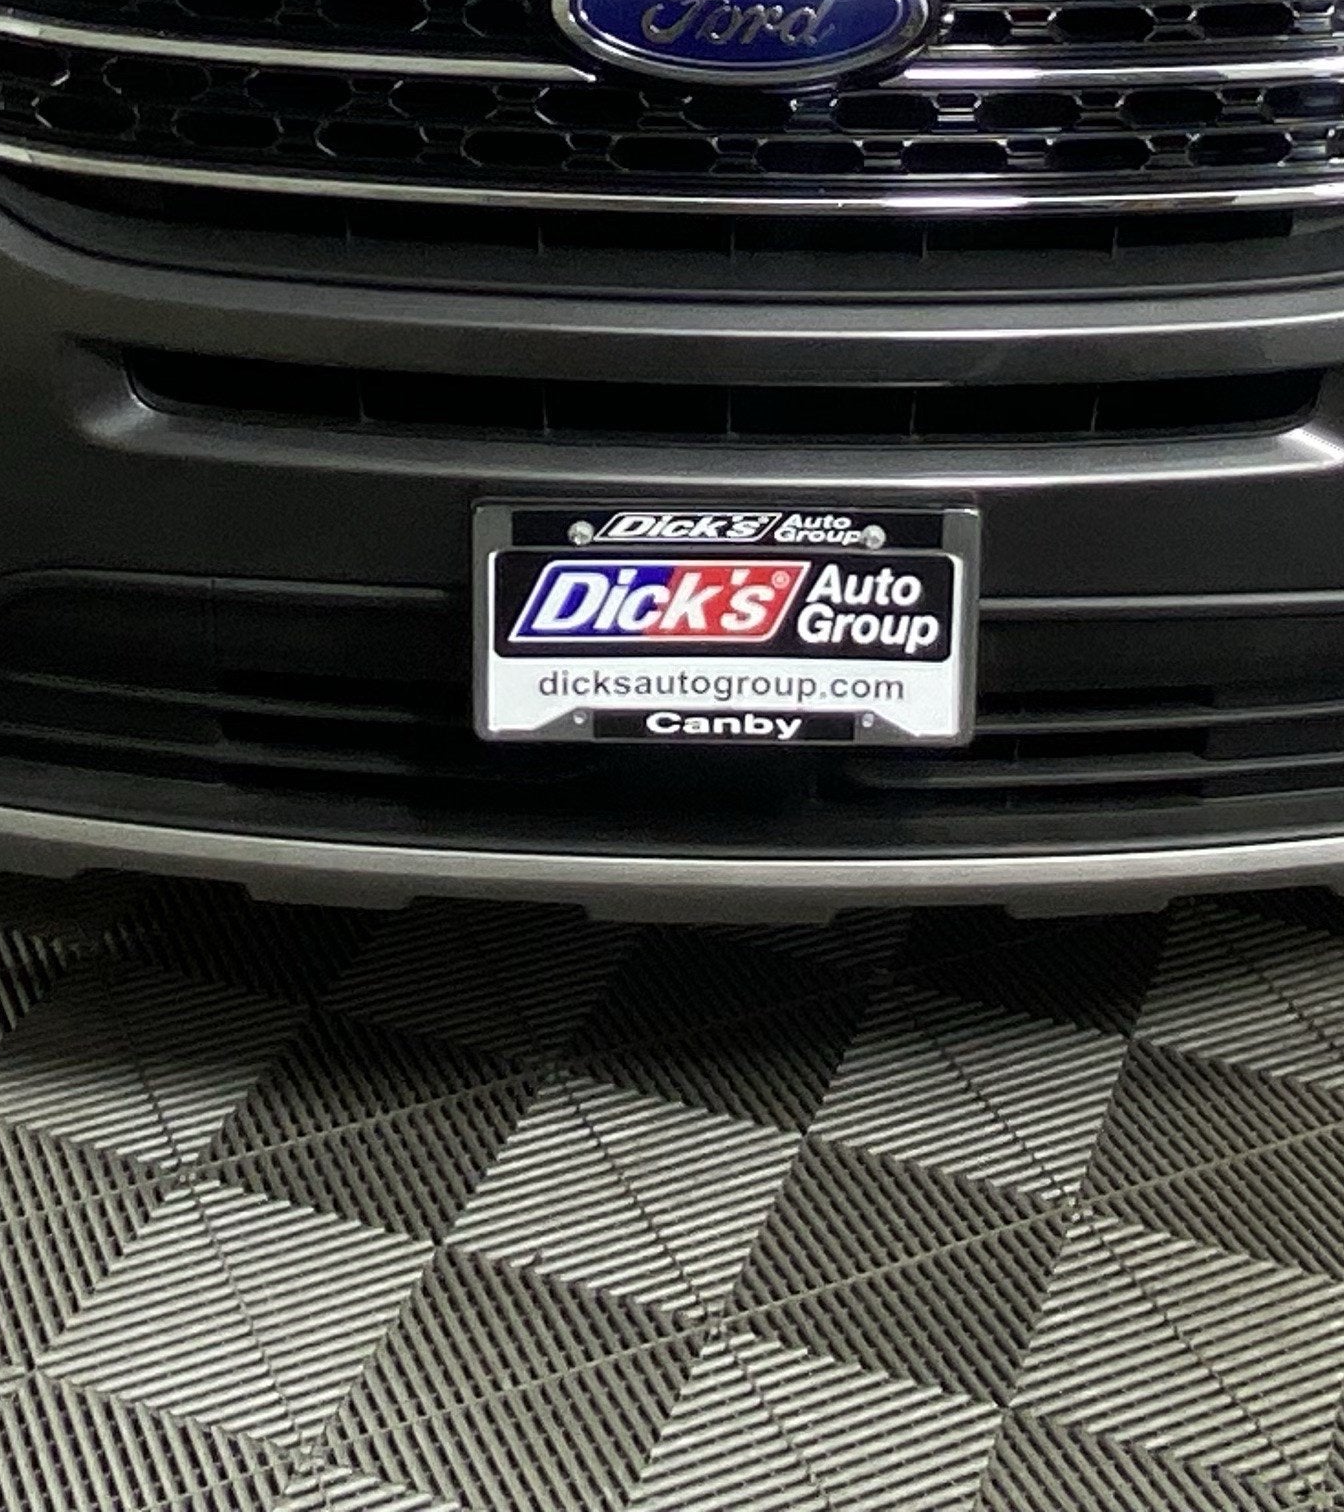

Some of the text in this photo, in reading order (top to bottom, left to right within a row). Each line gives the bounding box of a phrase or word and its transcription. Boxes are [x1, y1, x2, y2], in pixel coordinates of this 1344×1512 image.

[607, 514, 761, 539] Dick's
[781, 513, 853, 529] Auto
[773, 527, 863, 546] Group
[807, 564, 921, 606] Auto
[531, 568, 774, 632] Dick's
[797, 605, 939, 653] Group
[538, 670, 905, 701] dicksautogroup.com
[645, 712, 803, 739] Canby
